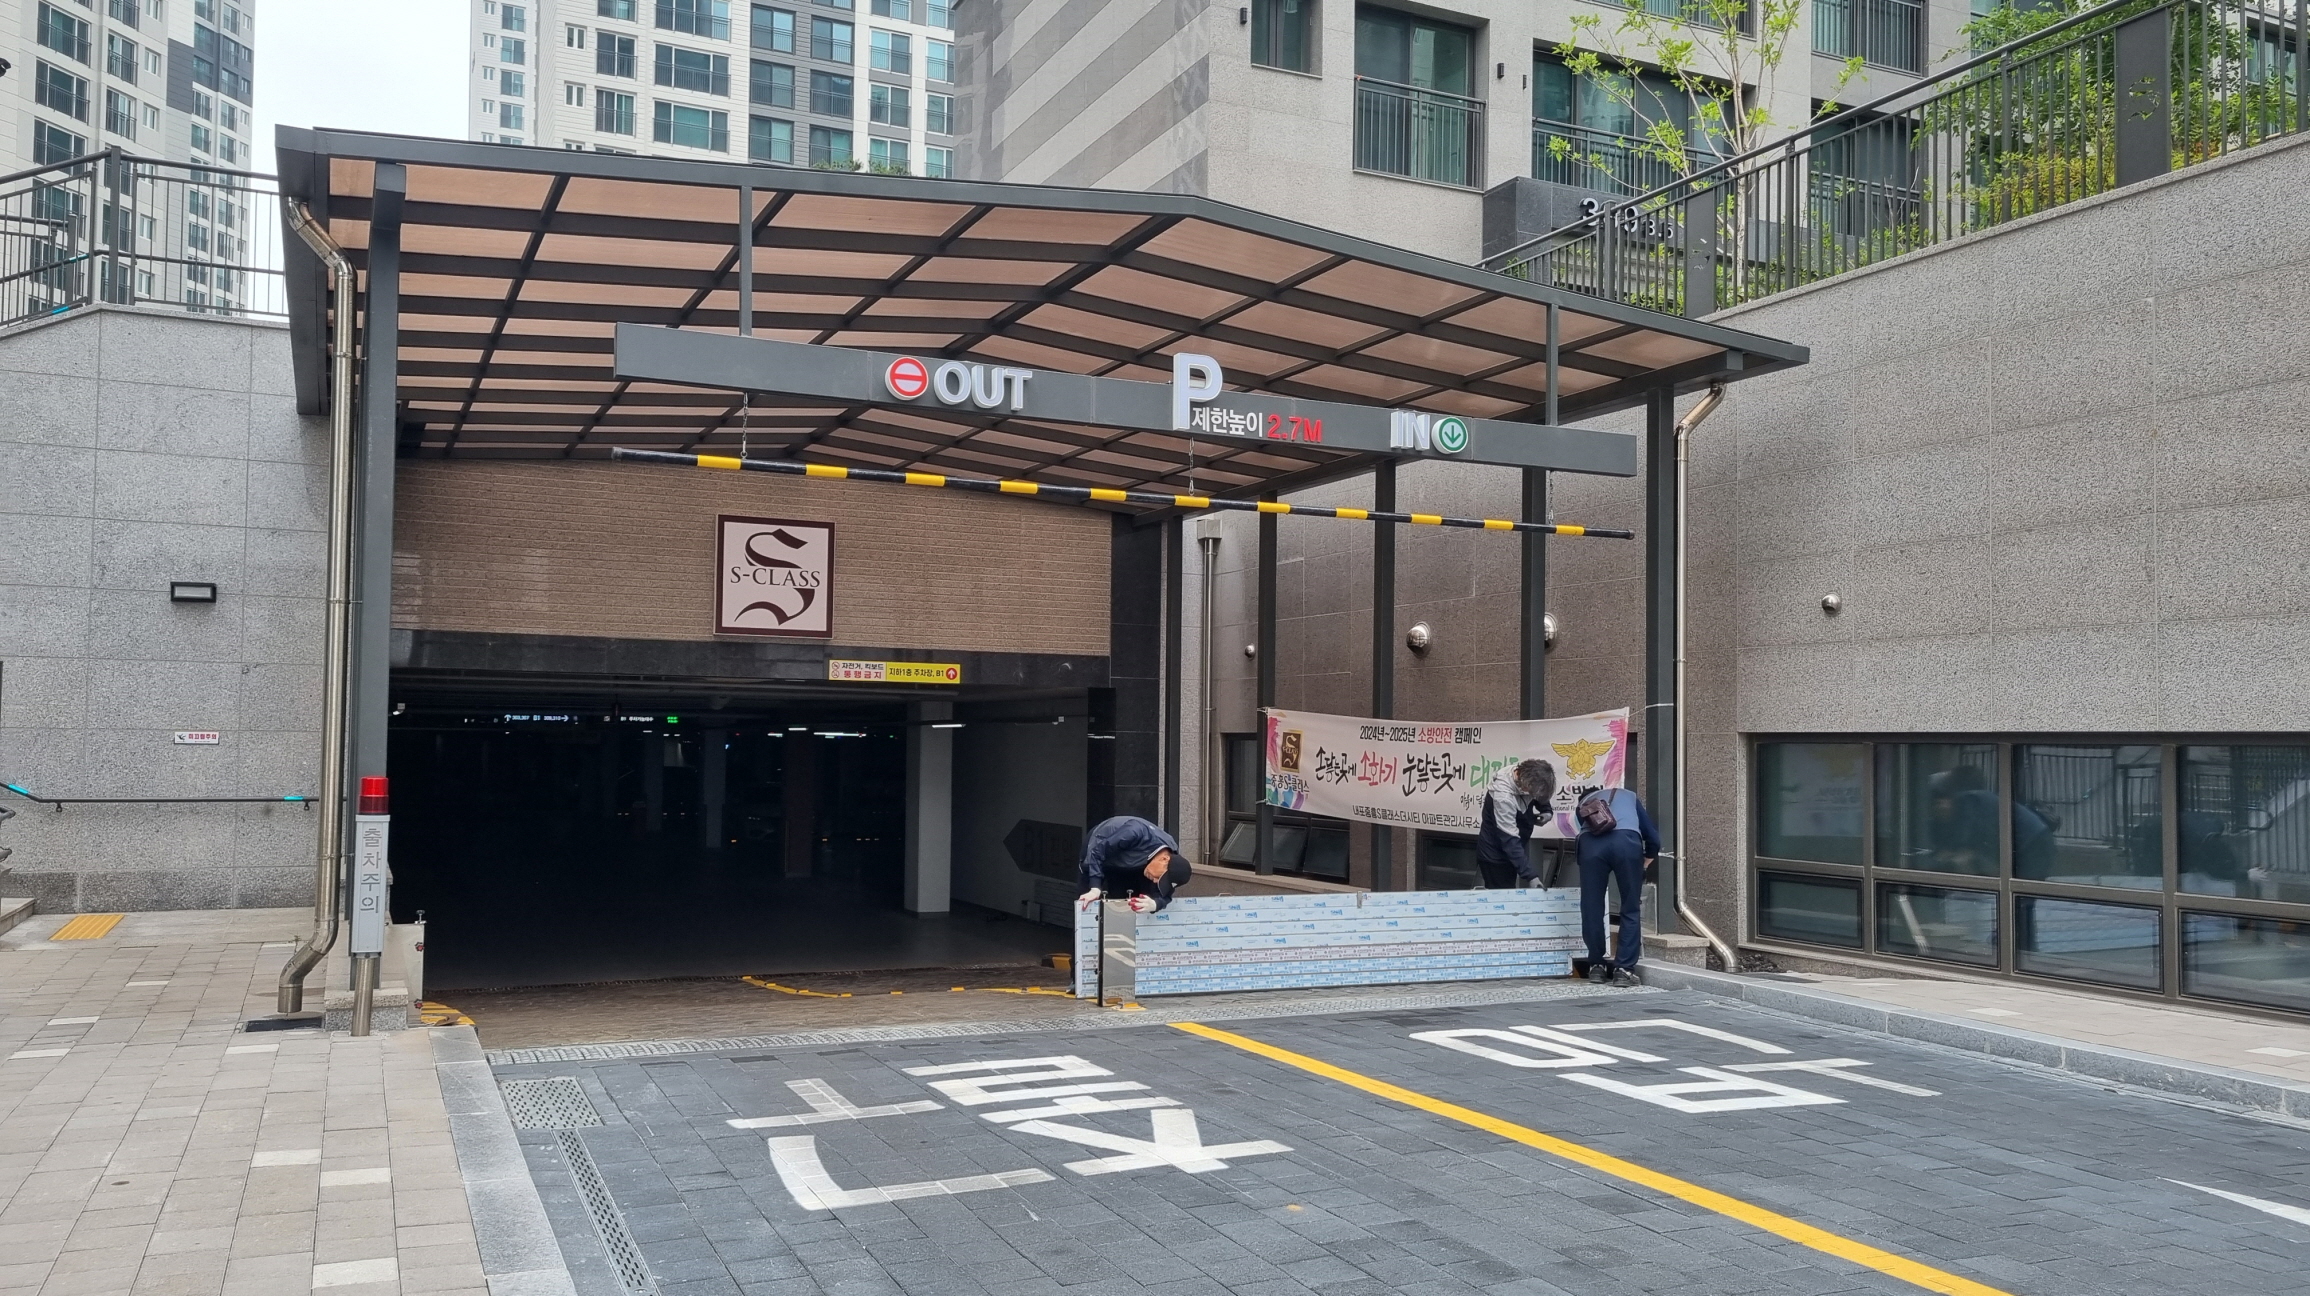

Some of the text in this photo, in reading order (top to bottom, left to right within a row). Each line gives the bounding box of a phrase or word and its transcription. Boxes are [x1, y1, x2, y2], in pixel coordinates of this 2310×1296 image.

[934, 361, 1033, 411] OUT
[1173, 352, 1223, 431] P
[1191, 406, 1323, 443] 제한높이 2.7M
[1390, 410, 1431, 450] IN
[730, 566, 821, 588] S-CLASS
[842, 662, 863, 670] 자전거,
[889, 667, 912, 677] 지하1층
[936, 669, 944, 677] B1
[1360, 726, 1482, 745] 2024년~2025년 소방안전 캠페인
[1357, 750, 1398, 787] 소화기
[360, 828, 382, 914] 출차주의
